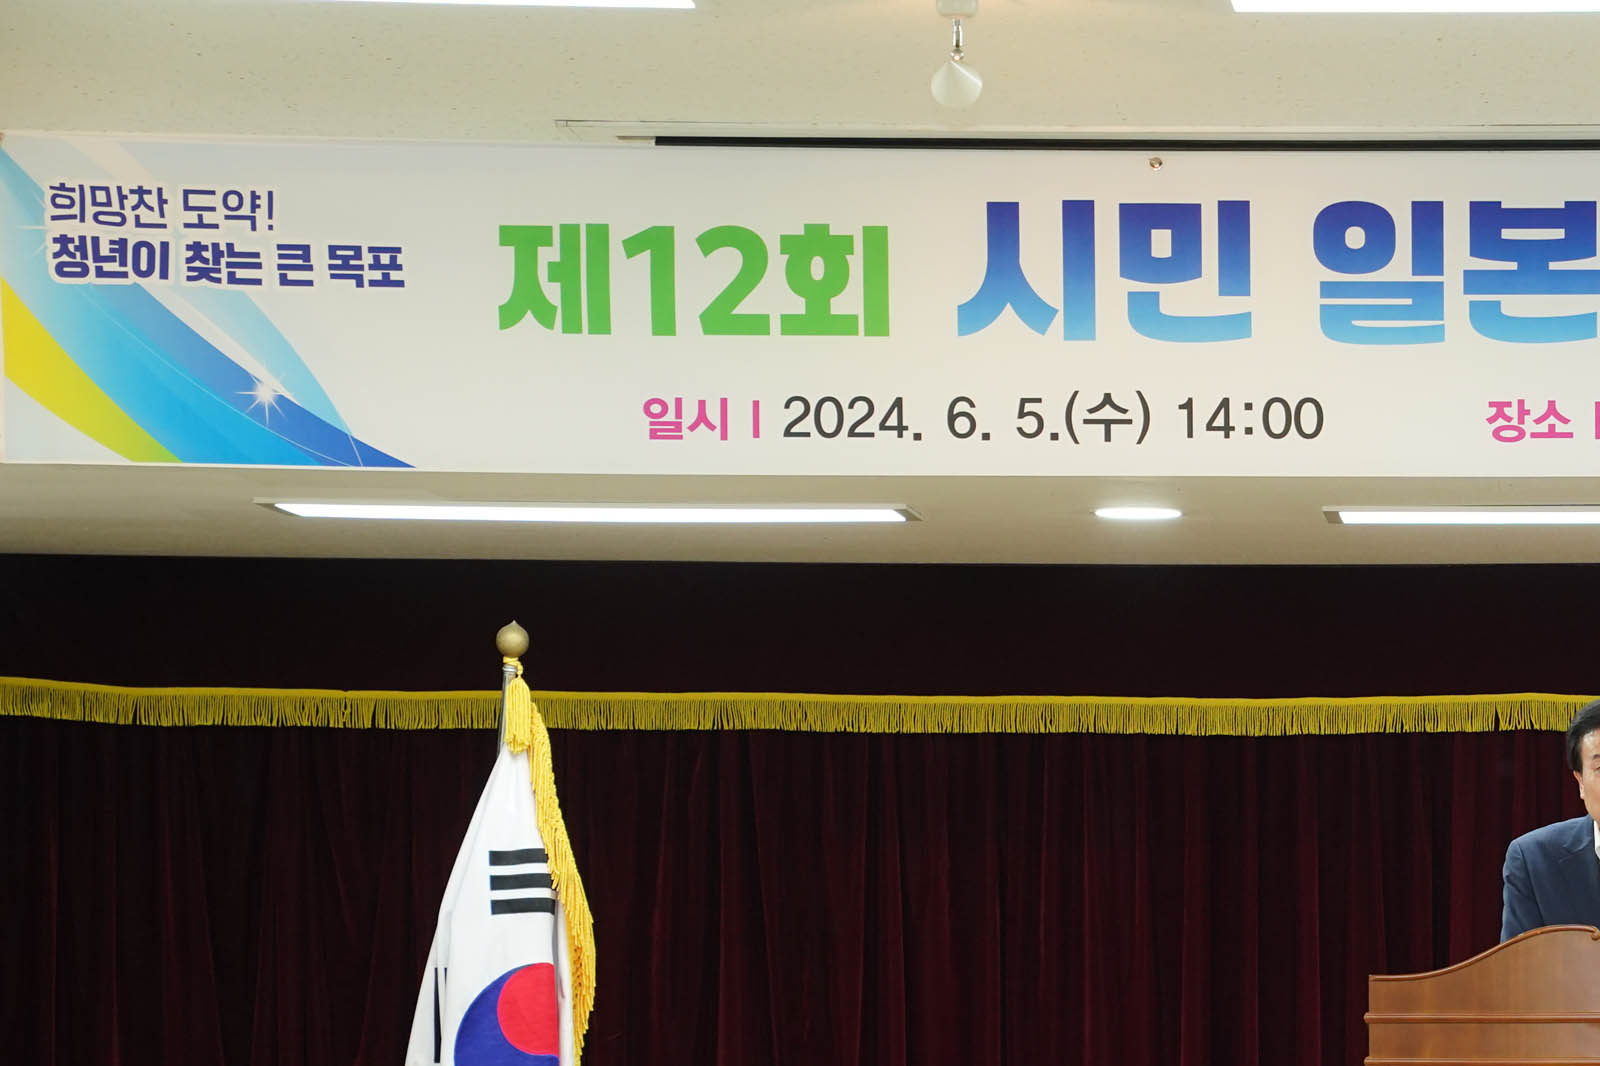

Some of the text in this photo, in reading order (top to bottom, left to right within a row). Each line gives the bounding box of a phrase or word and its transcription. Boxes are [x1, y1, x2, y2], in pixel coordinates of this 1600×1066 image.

[49, 182, 275, 232] 희망찬 도약!
[52, 233, 406, 289] 청년이 찾는 큰 목포
[498, 223, 890, 337] 제12회
[957, 199, 1252, 343] 시민
[642, 390, 1325, 445] 일시 2024. 6. 5.(수) 14:00
[1485, 398, 1575, 443] 장소
